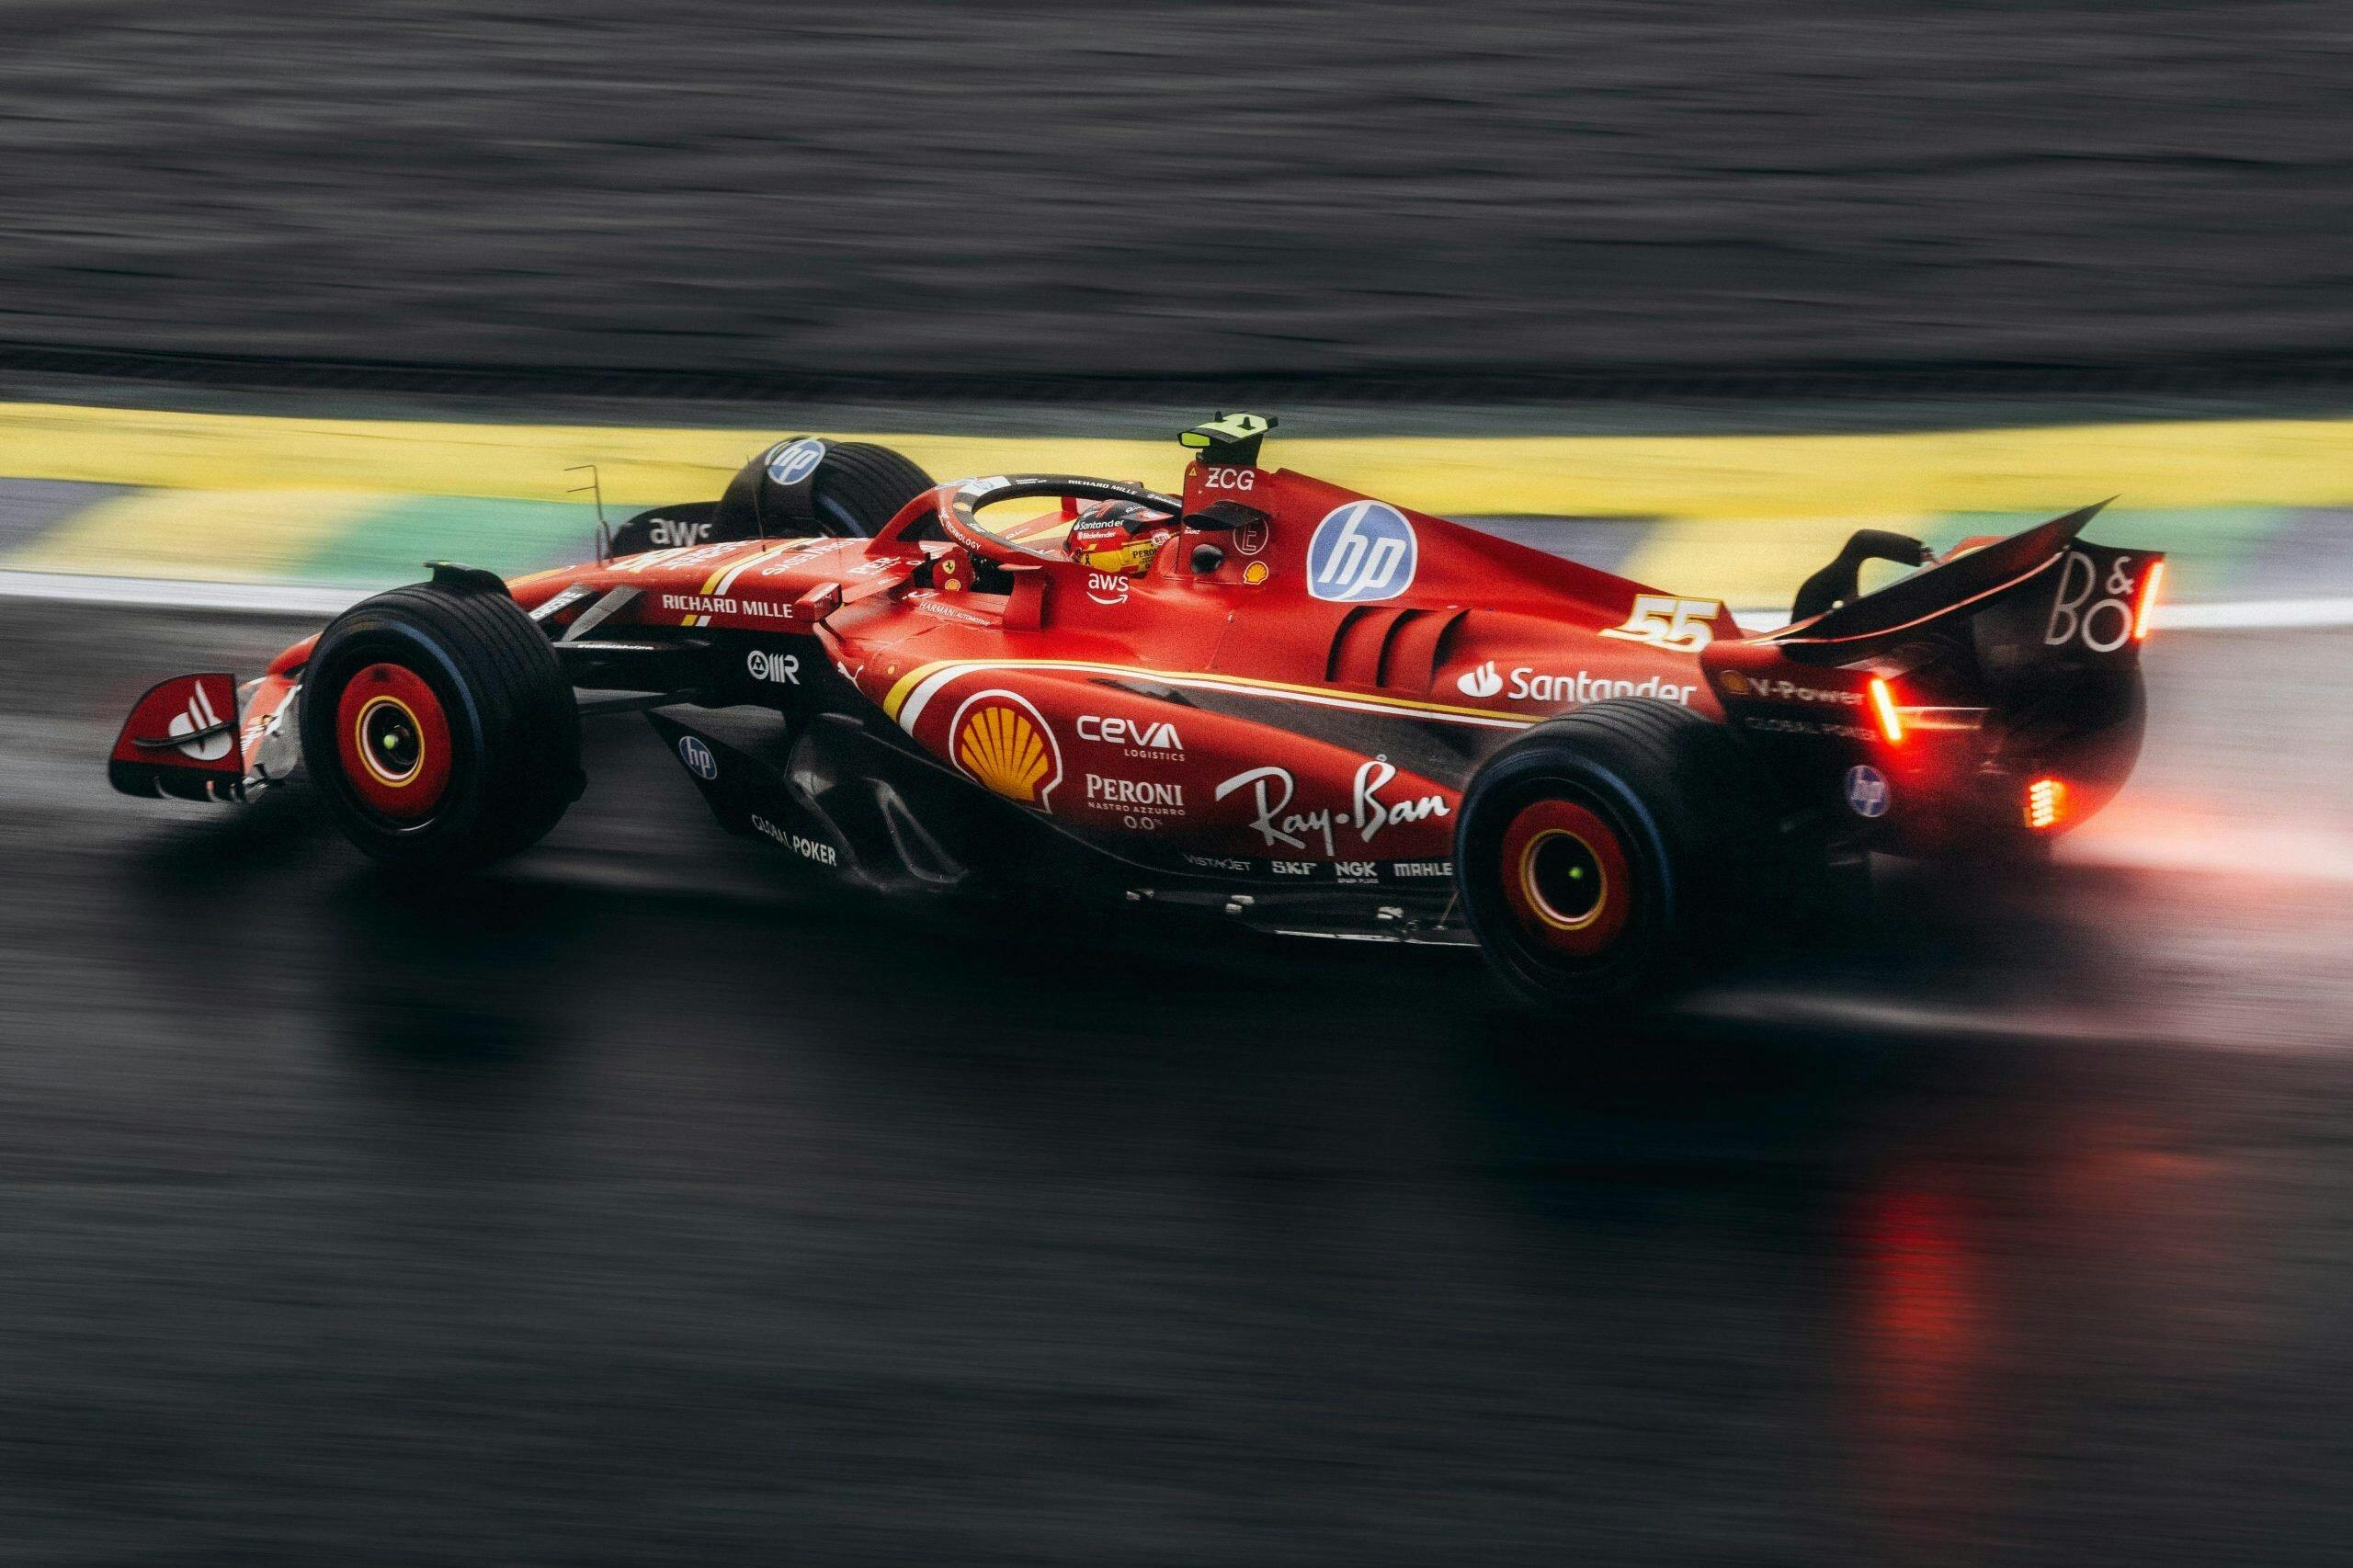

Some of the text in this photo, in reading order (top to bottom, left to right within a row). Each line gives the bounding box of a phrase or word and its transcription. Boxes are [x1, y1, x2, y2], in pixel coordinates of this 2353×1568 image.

[771, 440, 820, 483] hp
[1068, 479, 1138, 495] RICHARD MILLE
[1205, 467, 1256, 491] ZCG
[1079, 519, 1125, 530] Santander
[1318, 502, 1407, 600] hp
[1088, 573, 1130, 592] aws
[662, 594, 737, 614] RICHARD
[743, 600, 793, 619] MILLE
[919, 601, 955, 618] HARMAN
[1597, 594, 1723, 653] 55
[1507, 667, 1698, 706] Santander
[686, 736, 712, 779] hp
[1123, 748, 1186, 762] LOGISTICS
[1085, 773, 1185, 806] PERONI
[1087, 801, 1186, 816] NASTRO AZZURRO
[792, 835, 837, 867] POKER
[1271, 860, 1318, 875] SKF
[1335, 861, 1378, 878] NGK
[1393, 862, 1453, 877] MAHLE
